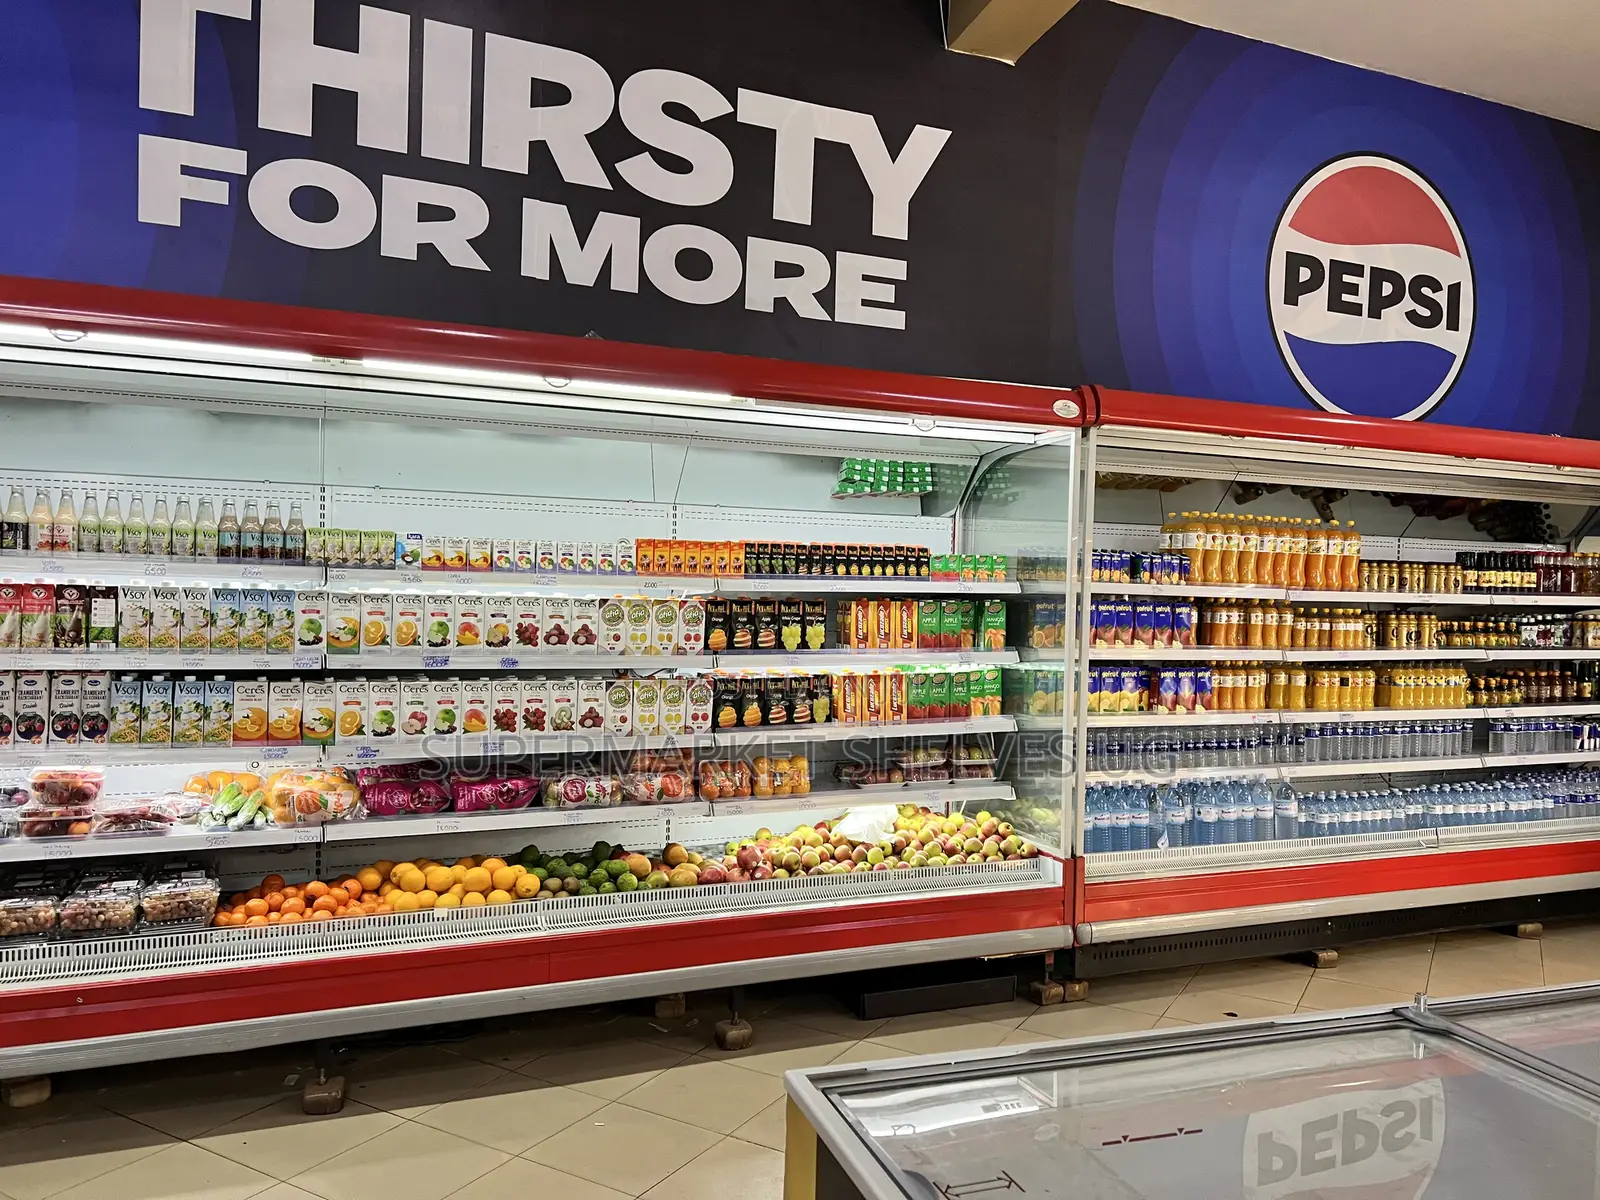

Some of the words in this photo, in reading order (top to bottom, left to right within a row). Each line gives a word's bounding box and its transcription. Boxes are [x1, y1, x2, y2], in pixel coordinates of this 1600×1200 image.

[138, 0, 952, 241] THIRSTY
[138, 133, 490, 272] FOR
[520, 198, 908, 330] MORE
[1284, 251, 1461, 332] PEPSI
[297, 592, 325, 602] Ceres
[331, 595, 358, 605] Ceres
[364, 594, 390, 604] Ceres
[395, 595, 422, 605] Ceres
[427, 596, 453, 605] Ceres
[458, 596, 483, 606] Ceres
[487, 597, 512, 606] Ceres
[516, 597, 541, 607] Ceres
[545, 598, 570, 607] Ceres
[573, 599, 597, 608] Ceres
[236, 685, 265, 694] Ceres
[273, 685, 300, 694] Ceres
[306, 686, 334, 695] Ceres
[339, 684, 366, 693] Ceres
[371, 684, 398, 693] Ceres
[402, 683, 429, 693] Ceres
[433, 683, 460, 693] Ceres
[464, 683, 490, 692] Ceres
[494, 683, 519, 692] Ceres
[523, 683, 548, 692] Ceres
[551, 683, 575, 692] Ceres
[580, 682, 604, 691] Ceres
